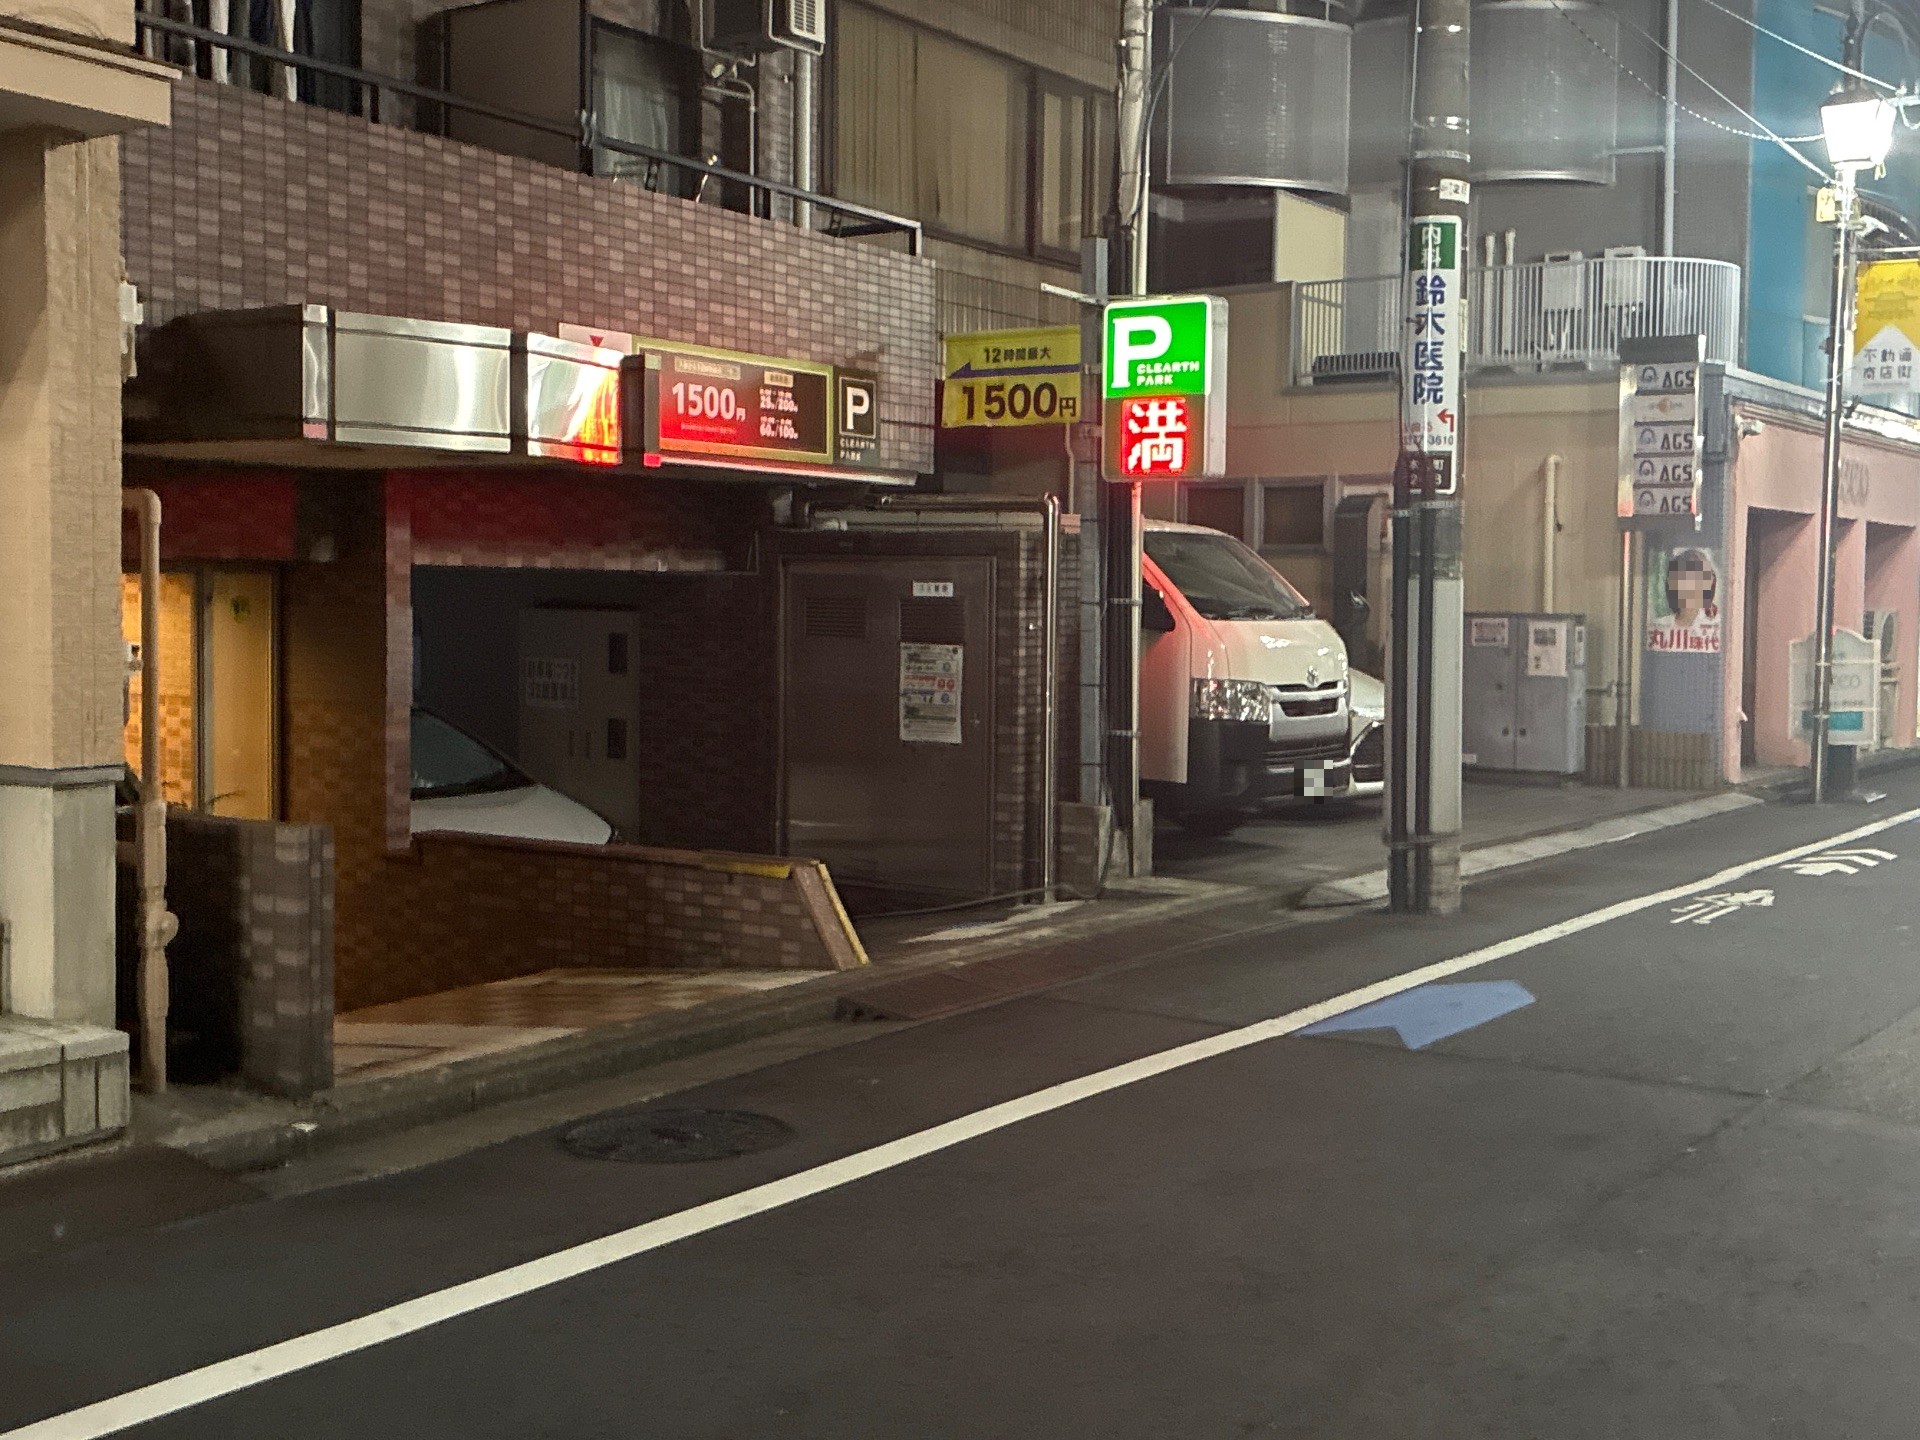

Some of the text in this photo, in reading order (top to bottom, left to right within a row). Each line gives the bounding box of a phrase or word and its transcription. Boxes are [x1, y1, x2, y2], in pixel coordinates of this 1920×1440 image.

[1421, 227, 1442, 269] 内科
[1111, 315, 1172, 388] P
[1412, 274, 1446, 405] 鈴木医院
[984, 346, 1051, 363] 12時間最大
[1136, 361, 1200, 375] CLEARTH
[1136, 374, 1174, 387] PARK
[1662, 370, 1694, 388] AGS
[672, 382, 746, 421] 1500円
[847, 386, 870, 429] P
[961, 382, 1077, 420] 1500円
[1128, 400, 1187, 471] 満
[1660, 433, 1693, 450] AGS
[1659, 464, 1692, 482] AGS
[1659, 495, 1692, 513] AGS
